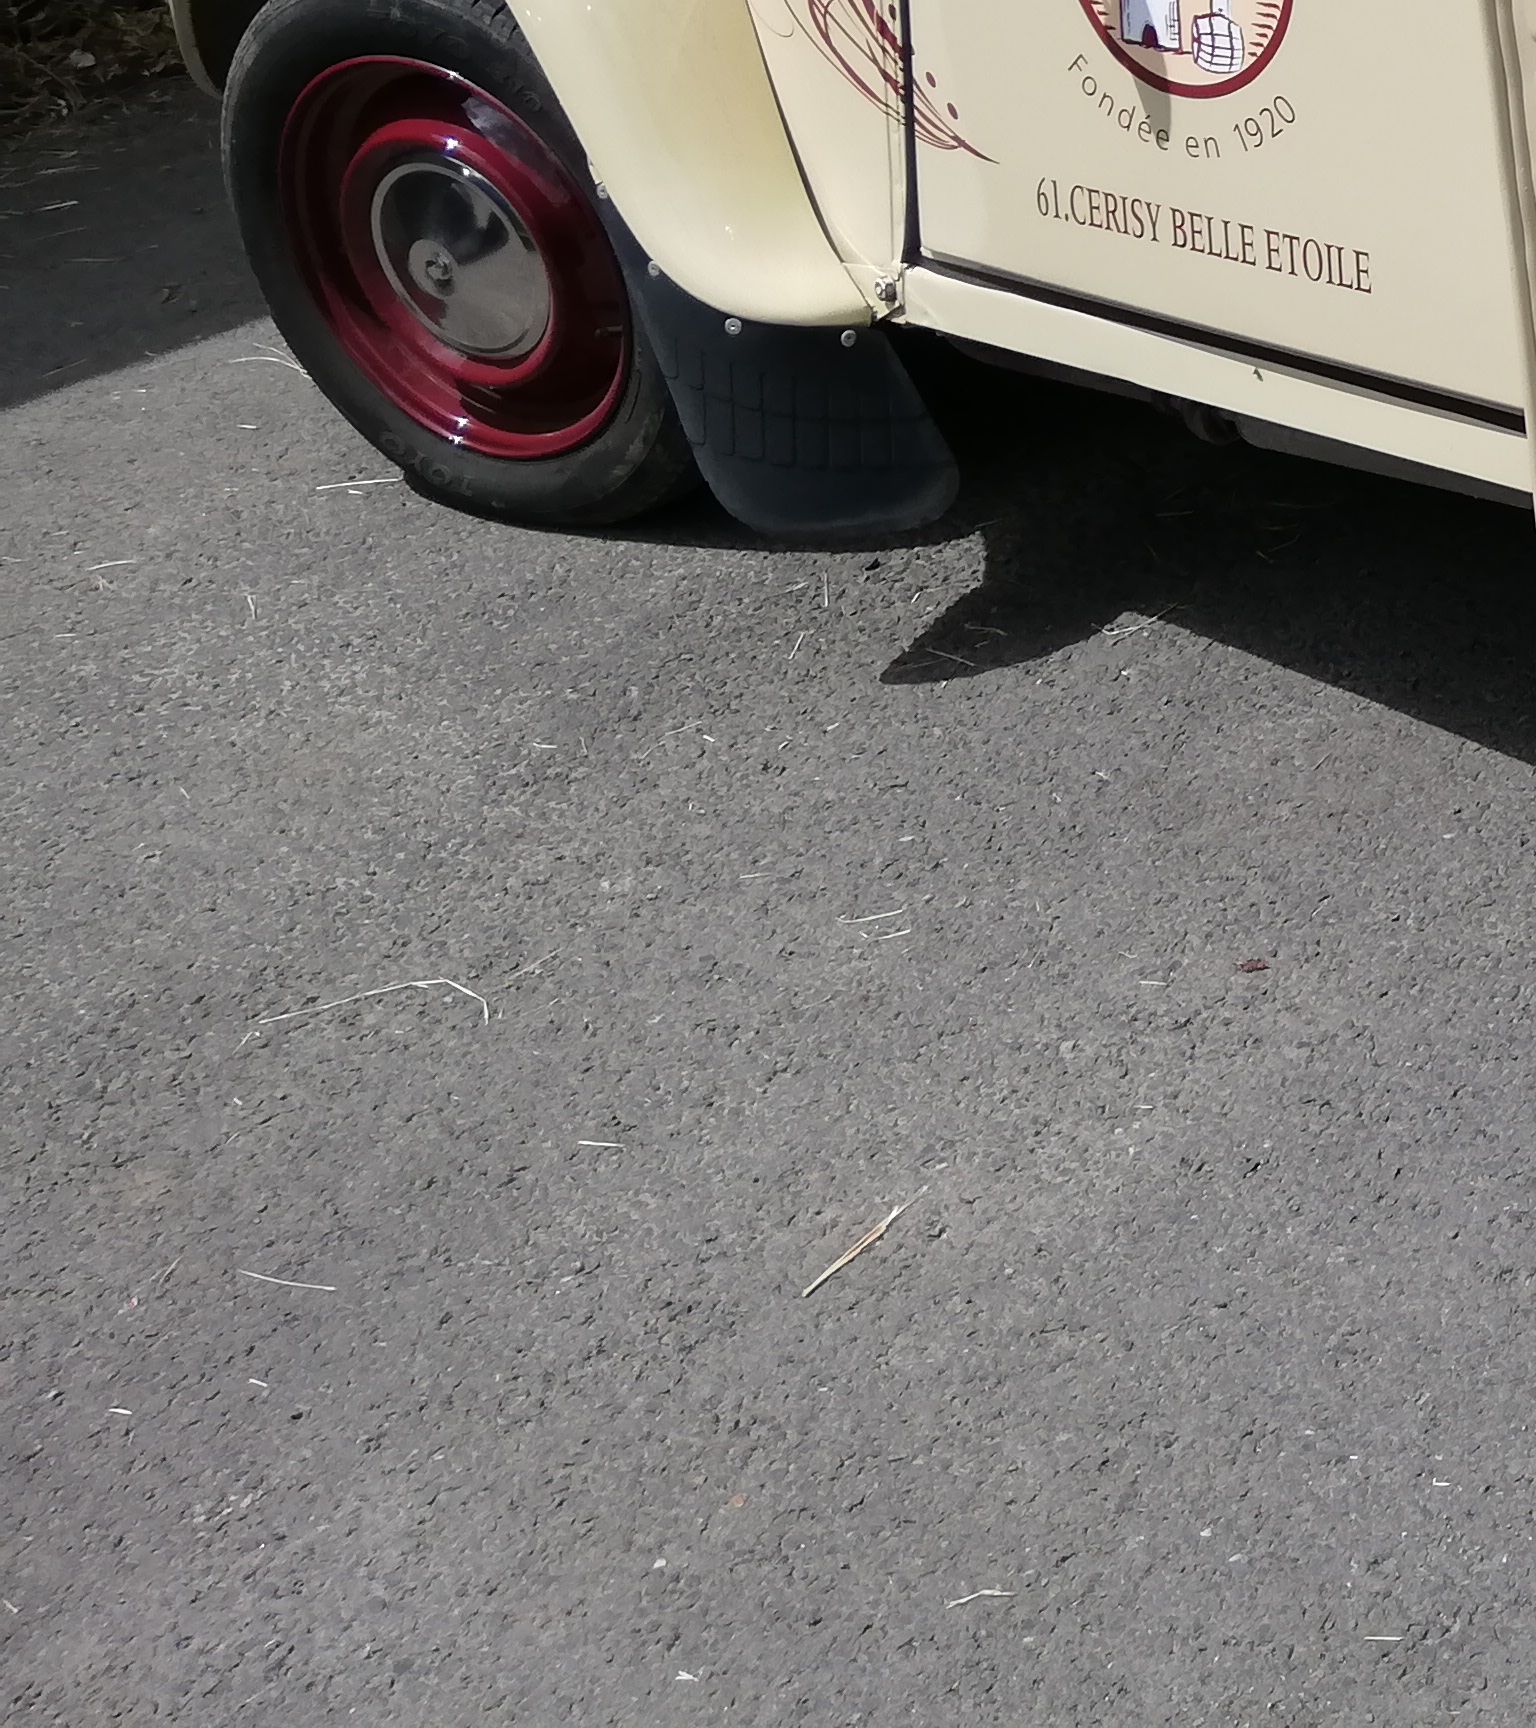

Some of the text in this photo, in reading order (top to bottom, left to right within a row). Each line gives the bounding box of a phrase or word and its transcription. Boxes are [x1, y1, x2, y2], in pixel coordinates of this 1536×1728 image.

[1067, 53, 1298, 159] Fondée en 1920
[1036, 177, 1374, 294] 61.CERISY BELLE ETOILE
